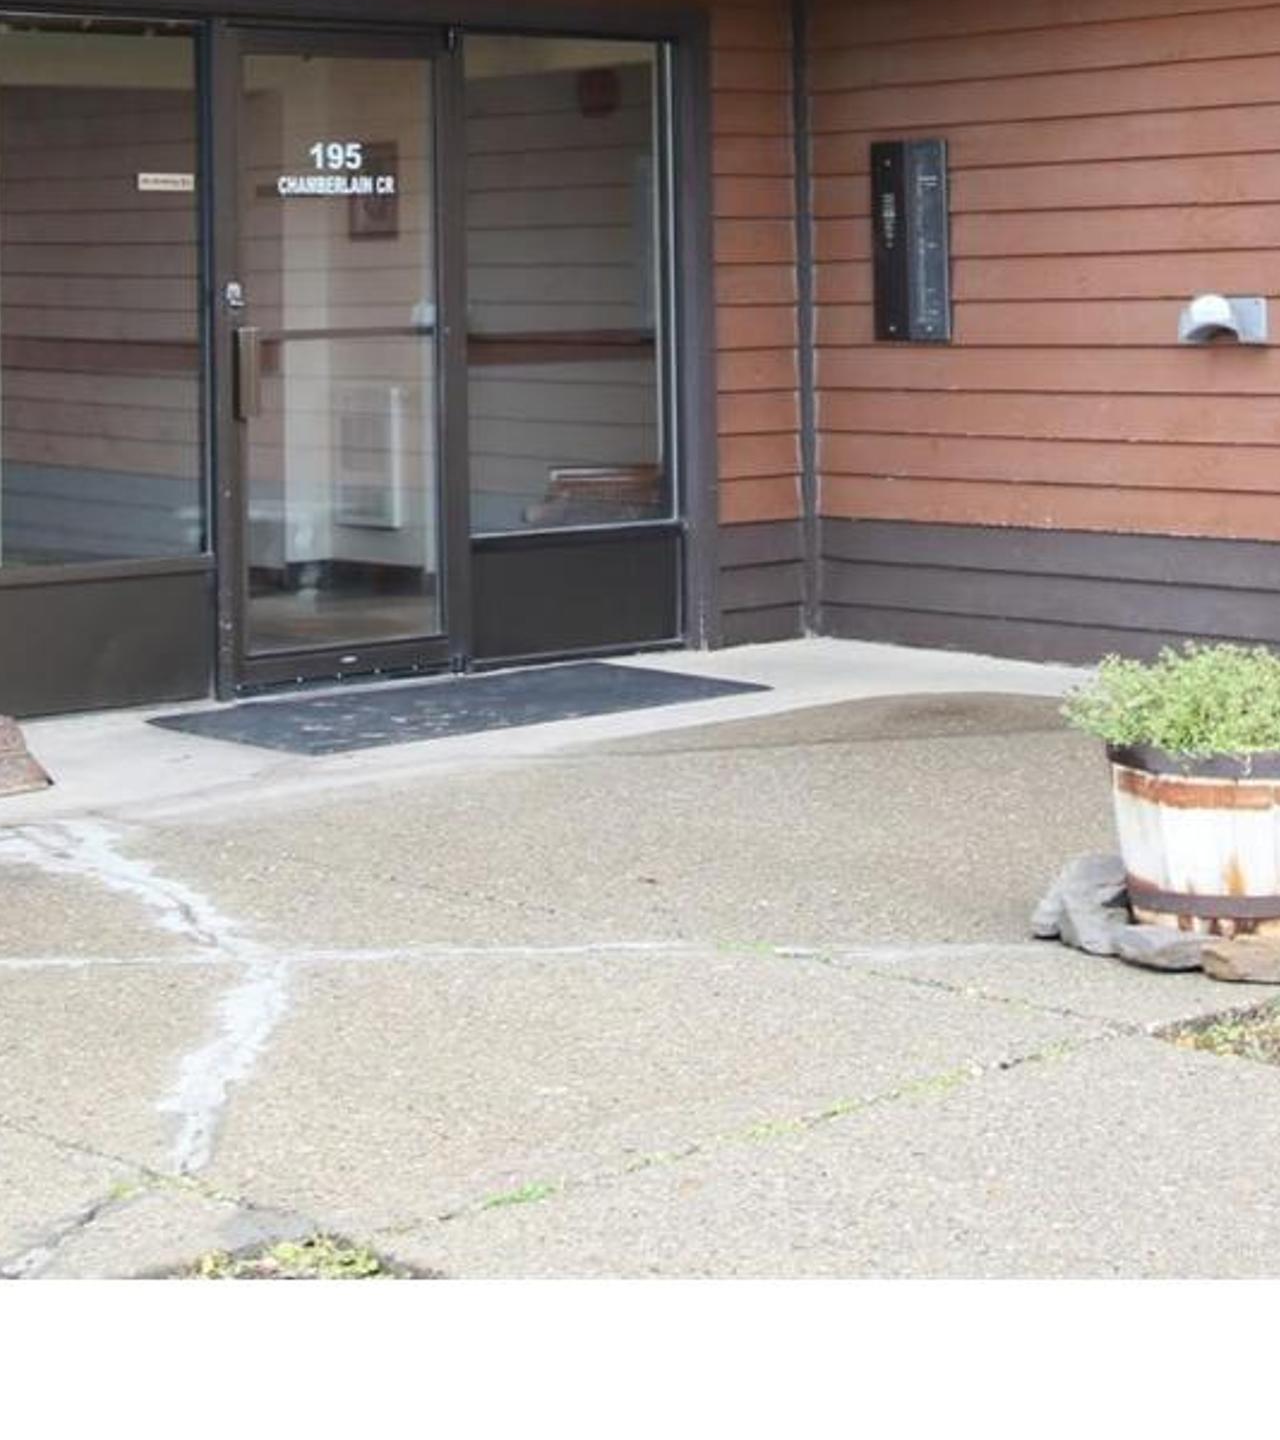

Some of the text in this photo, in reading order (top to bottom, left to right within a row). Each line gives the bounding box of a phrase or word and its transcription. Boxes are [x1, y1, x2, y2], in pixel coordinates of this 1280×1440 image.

[309, 142, 362, 170] 195
[277, 175, 395, 195] CHAMBERLAIN CR
